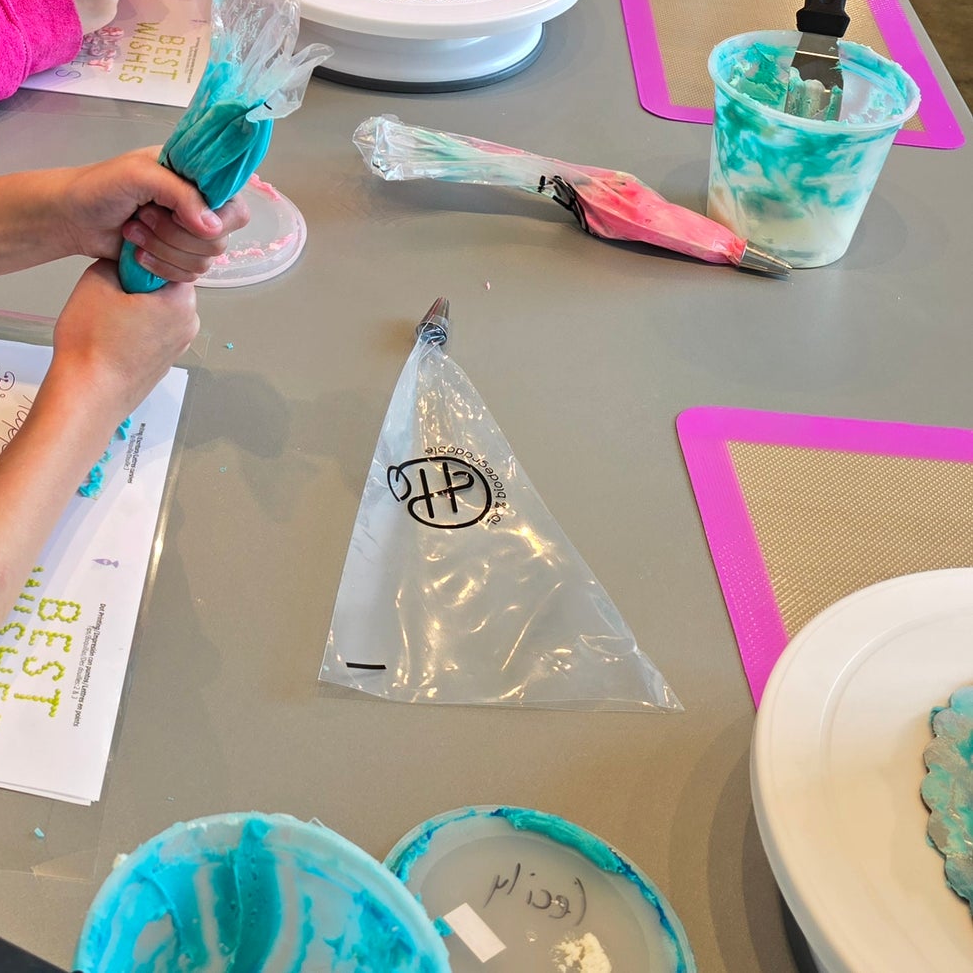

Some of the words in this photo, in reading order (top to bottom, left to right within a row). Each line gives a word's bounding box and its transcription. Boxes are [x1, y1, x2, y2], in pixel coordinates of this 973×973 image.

[117, 21, 161, 85] WISHES
[148, 34, 186, 82] BEST
[13, 596, 82, 718] BEST
